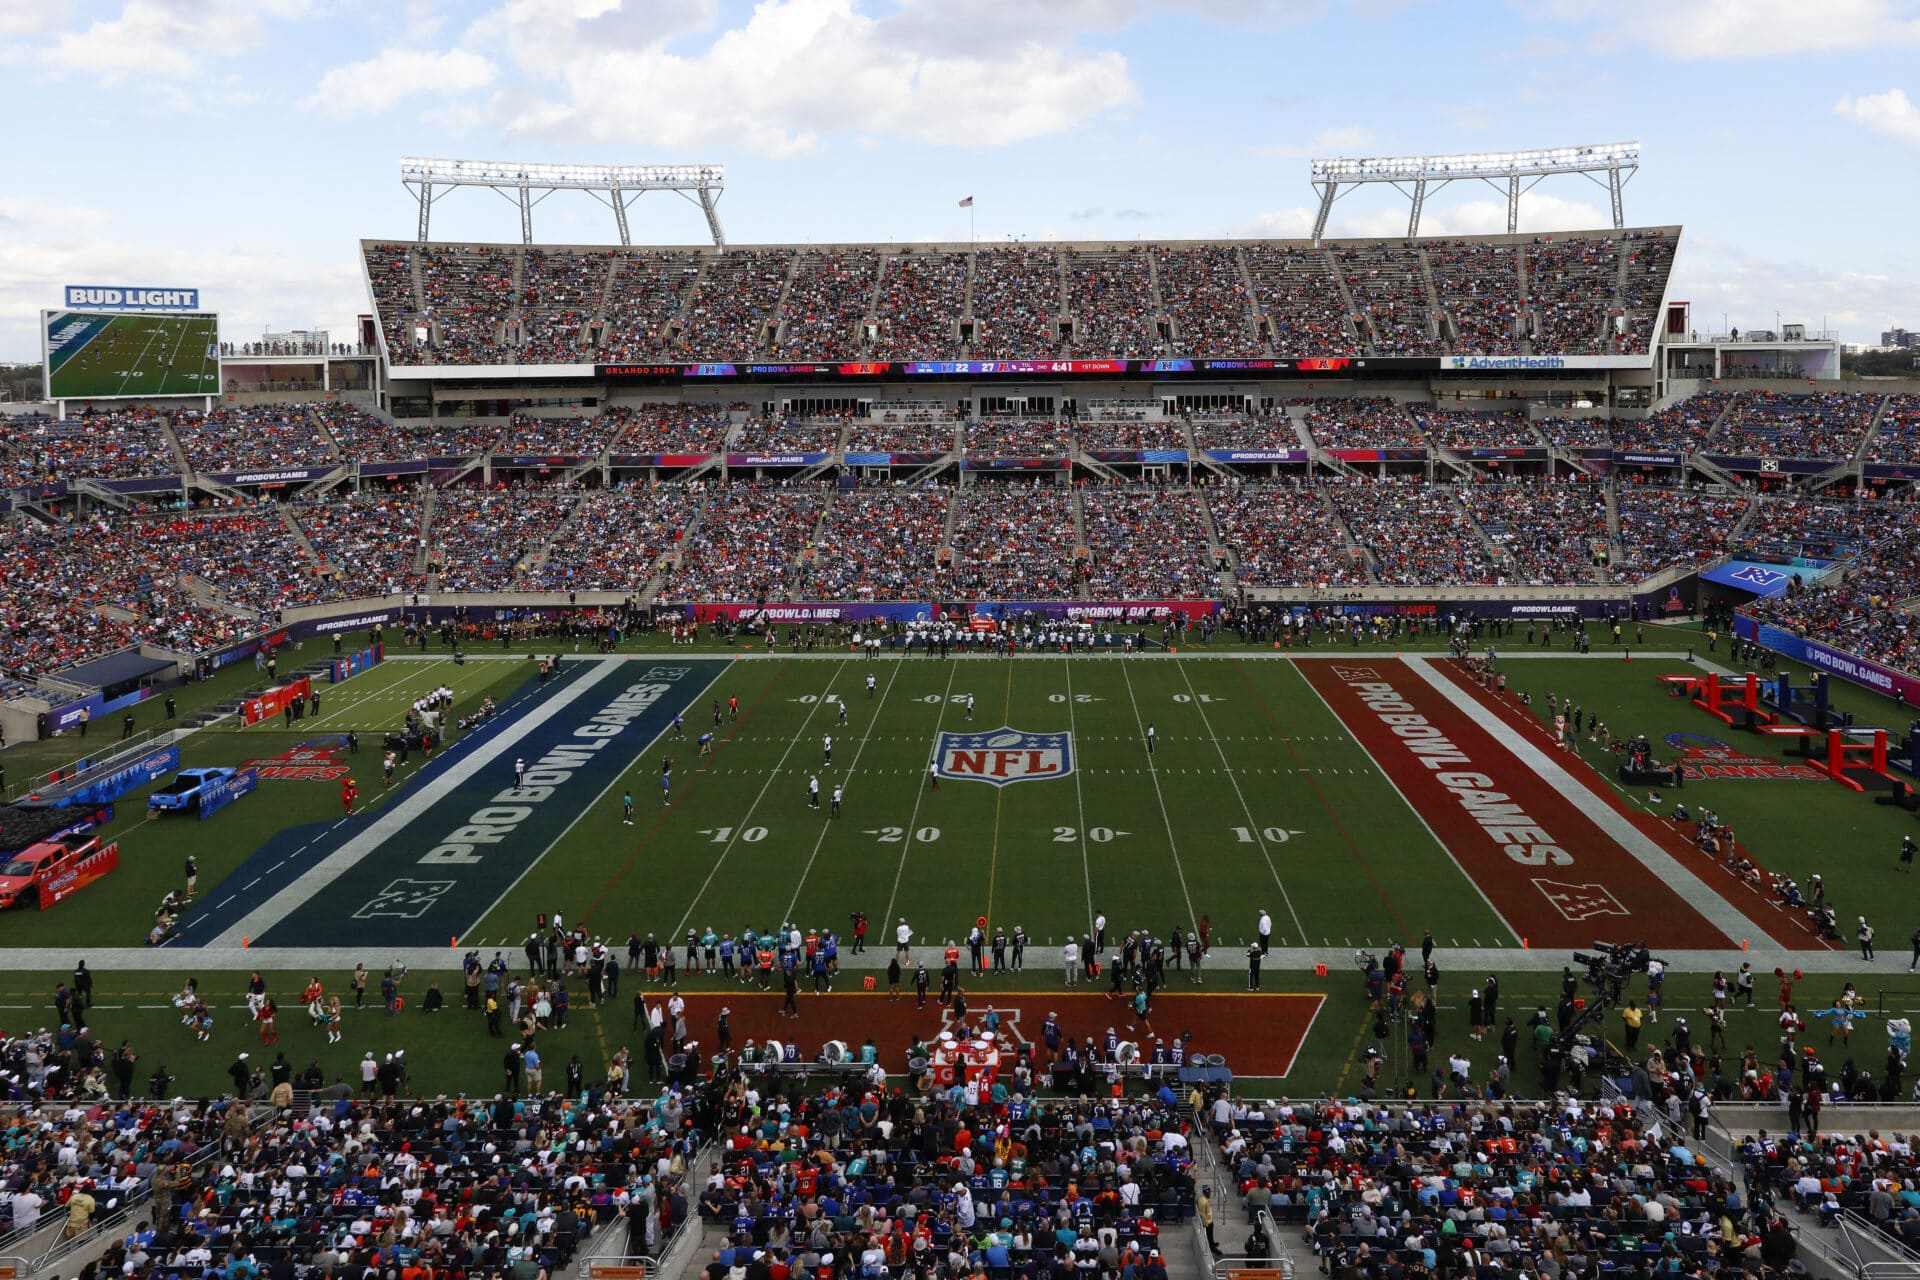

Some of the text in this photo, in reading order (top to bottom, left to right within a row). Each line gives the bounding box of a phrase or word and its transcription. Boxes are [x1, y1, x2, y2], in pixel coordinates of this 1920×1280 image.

[69, 289, 195, 306] BUD LIGHT
[955, 363, 968, 372] 22
[981, 363, 994, 372] 27
[1051, 362, 1072, 372] 4:41
[1469, 357, 1565, 368] AdventHealth
[1763, 461, 1777, 471] 25
[235, 471, 308, 483] #PROBOWLGAMES
[1343, 604, 1366, 614] PRO
[1399, 604, 1438, 615] GAMES
[316, 614, 388, 632] #PROBOWLGAMES
[1814, 649, 1893, 690] PRO BOWL GAMES
[948, 749, 1058, 777] NFL
[417, 683, 671, 864] PRO BOWL GAMES
[1350, 682, 1574, 866] PRO BOWL GAMES
[709, 826, 768, 842] 10
[877, 826, 940, 842] 20
[1052, 826, 1114, 842] 20
[1229, 827, 1290, 843] 10
[1317, 965, 1325, 974] 10
[1110, 1038, 1116, 1048] 0
[784, 1048, 794, 1059] 70
[1068, 1051, 1077, 1060] 14
[1089, 1050, 1094, 1060] 6
[1157, 1052, 1164, 1064] 6
[1172, 1052, 1183, 1064] 92
[940, 1067, 954, 1081] G
[980, 1082, 988, 1092] 14
[1012, 1110, 1022, 1120] 17
[740, 1166, 750, 1175] 21
[802, 1181, 808, 1189] 10
[993, 1179, 1002, 1188] 16
[1329, 1190, 1337, 1200] 11
[332, 1197, 342, 1206] 17
